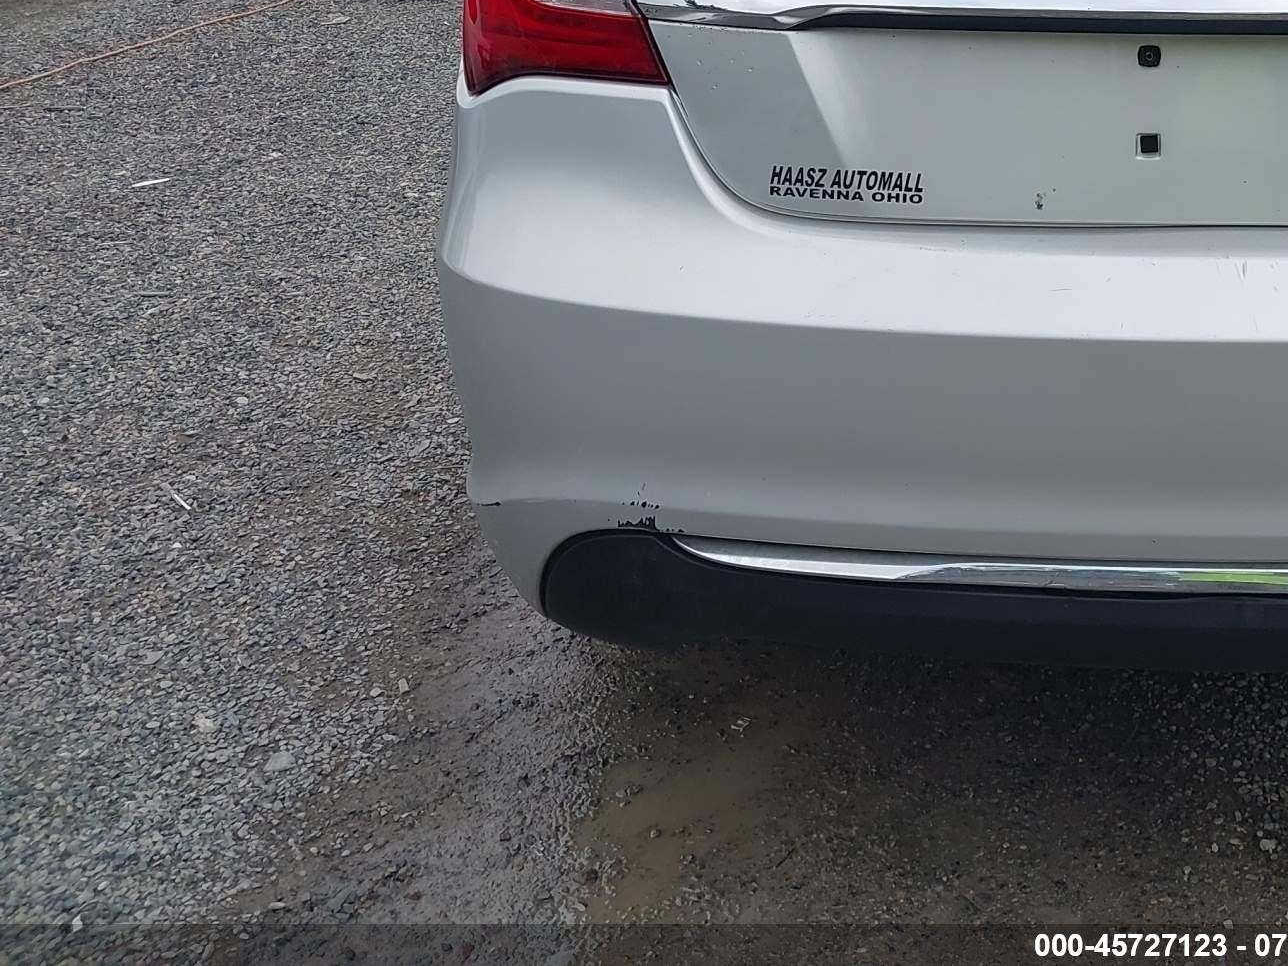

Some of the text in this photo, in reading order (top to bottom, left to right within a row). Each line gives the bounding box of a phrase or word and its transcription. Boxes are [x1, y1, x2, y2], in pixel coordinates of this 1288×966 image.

[770, 165, 924, 192] HAASZ AUTOMALL
[769, 186, 923, 204] RAVENNA OHIO
